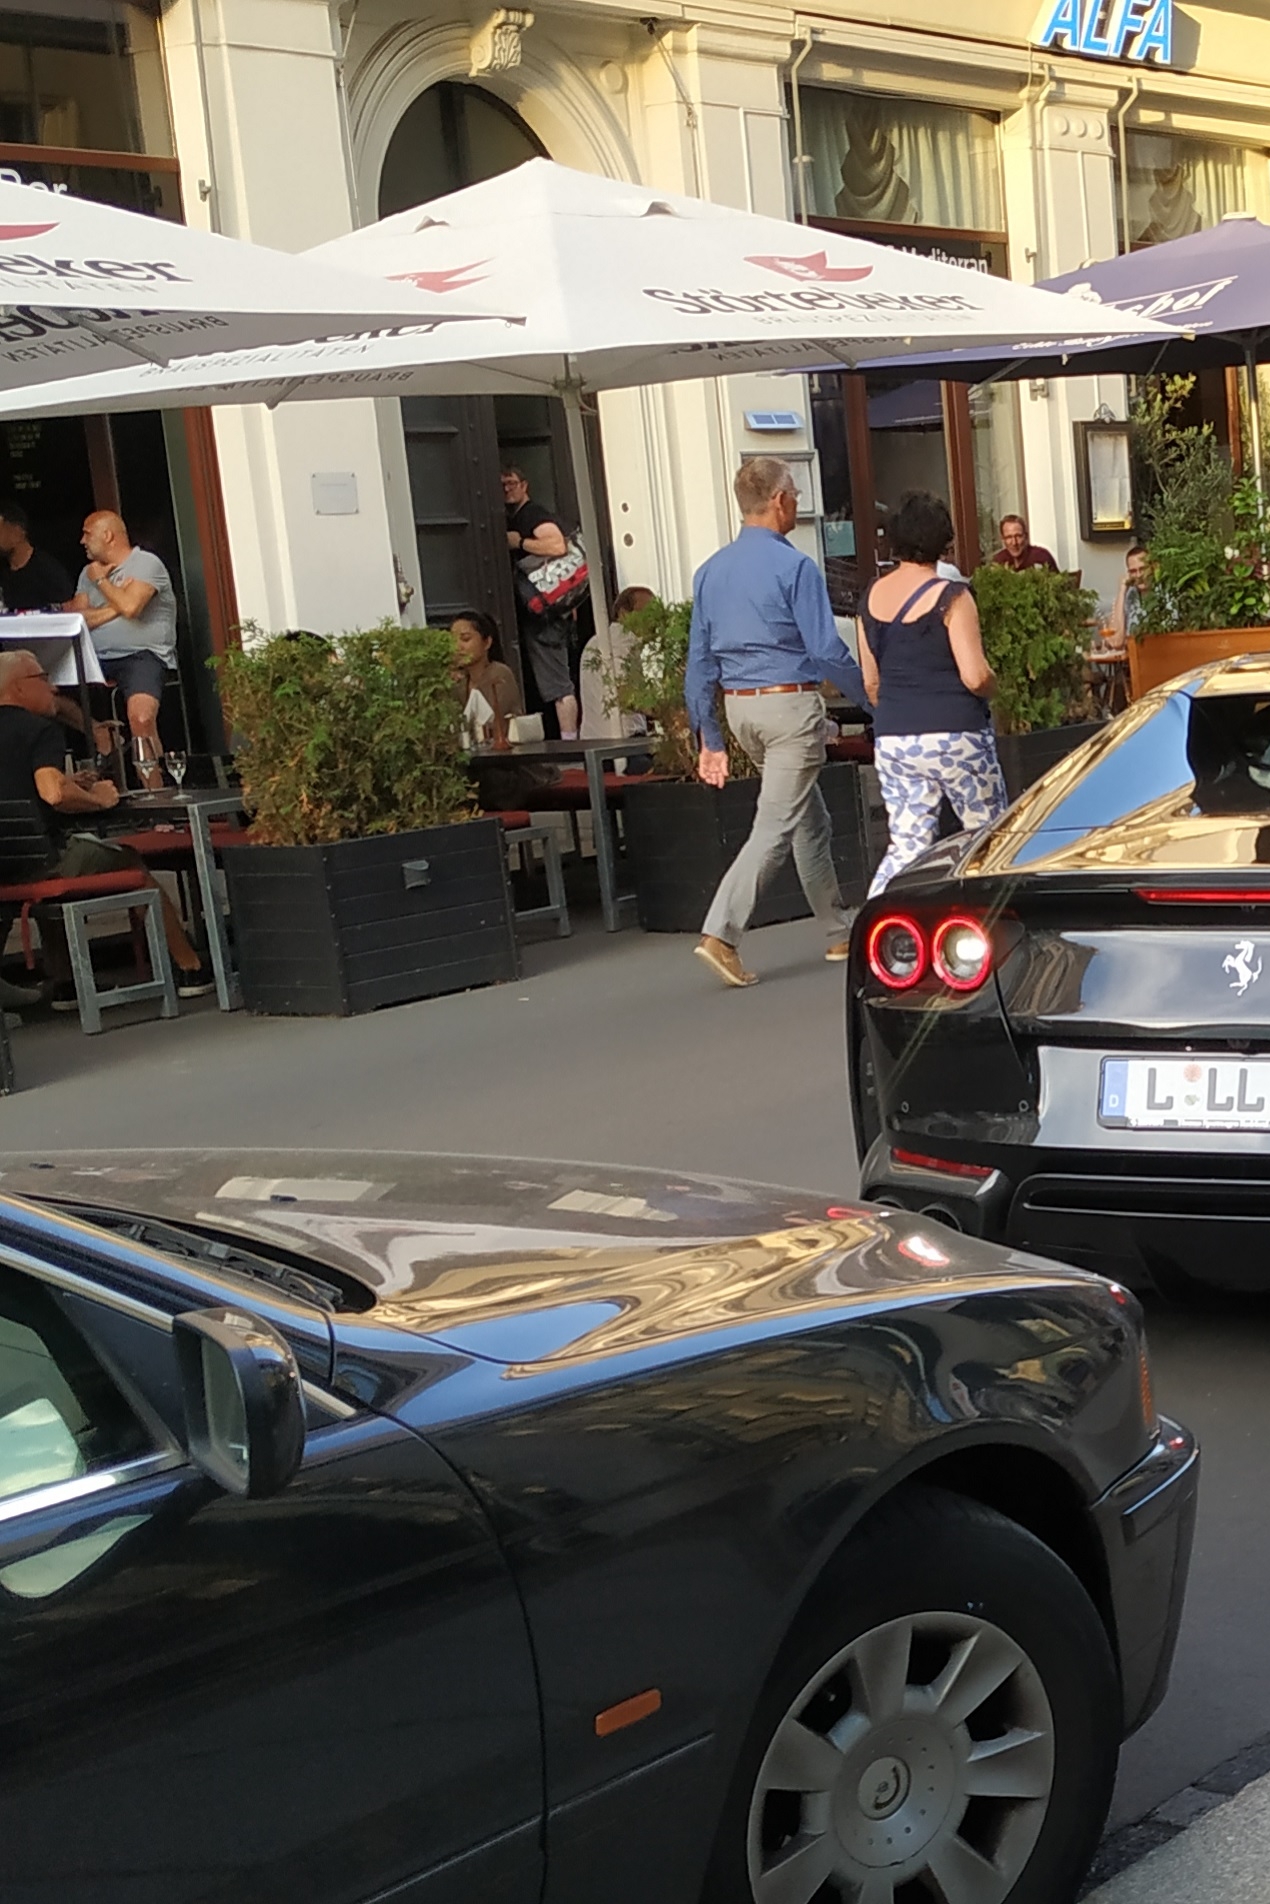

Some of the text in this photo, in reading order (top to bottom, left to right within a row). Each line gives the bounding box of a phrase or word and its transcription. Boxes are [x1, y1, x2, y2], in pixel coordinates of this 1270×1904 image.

[1040, 0, 1171, 63] ALFA
[642, 287, 985, 315] Störtebeker
[1146, 1067, 1174, 1110] L
[1206, 1067, 1265, 1112] LL
